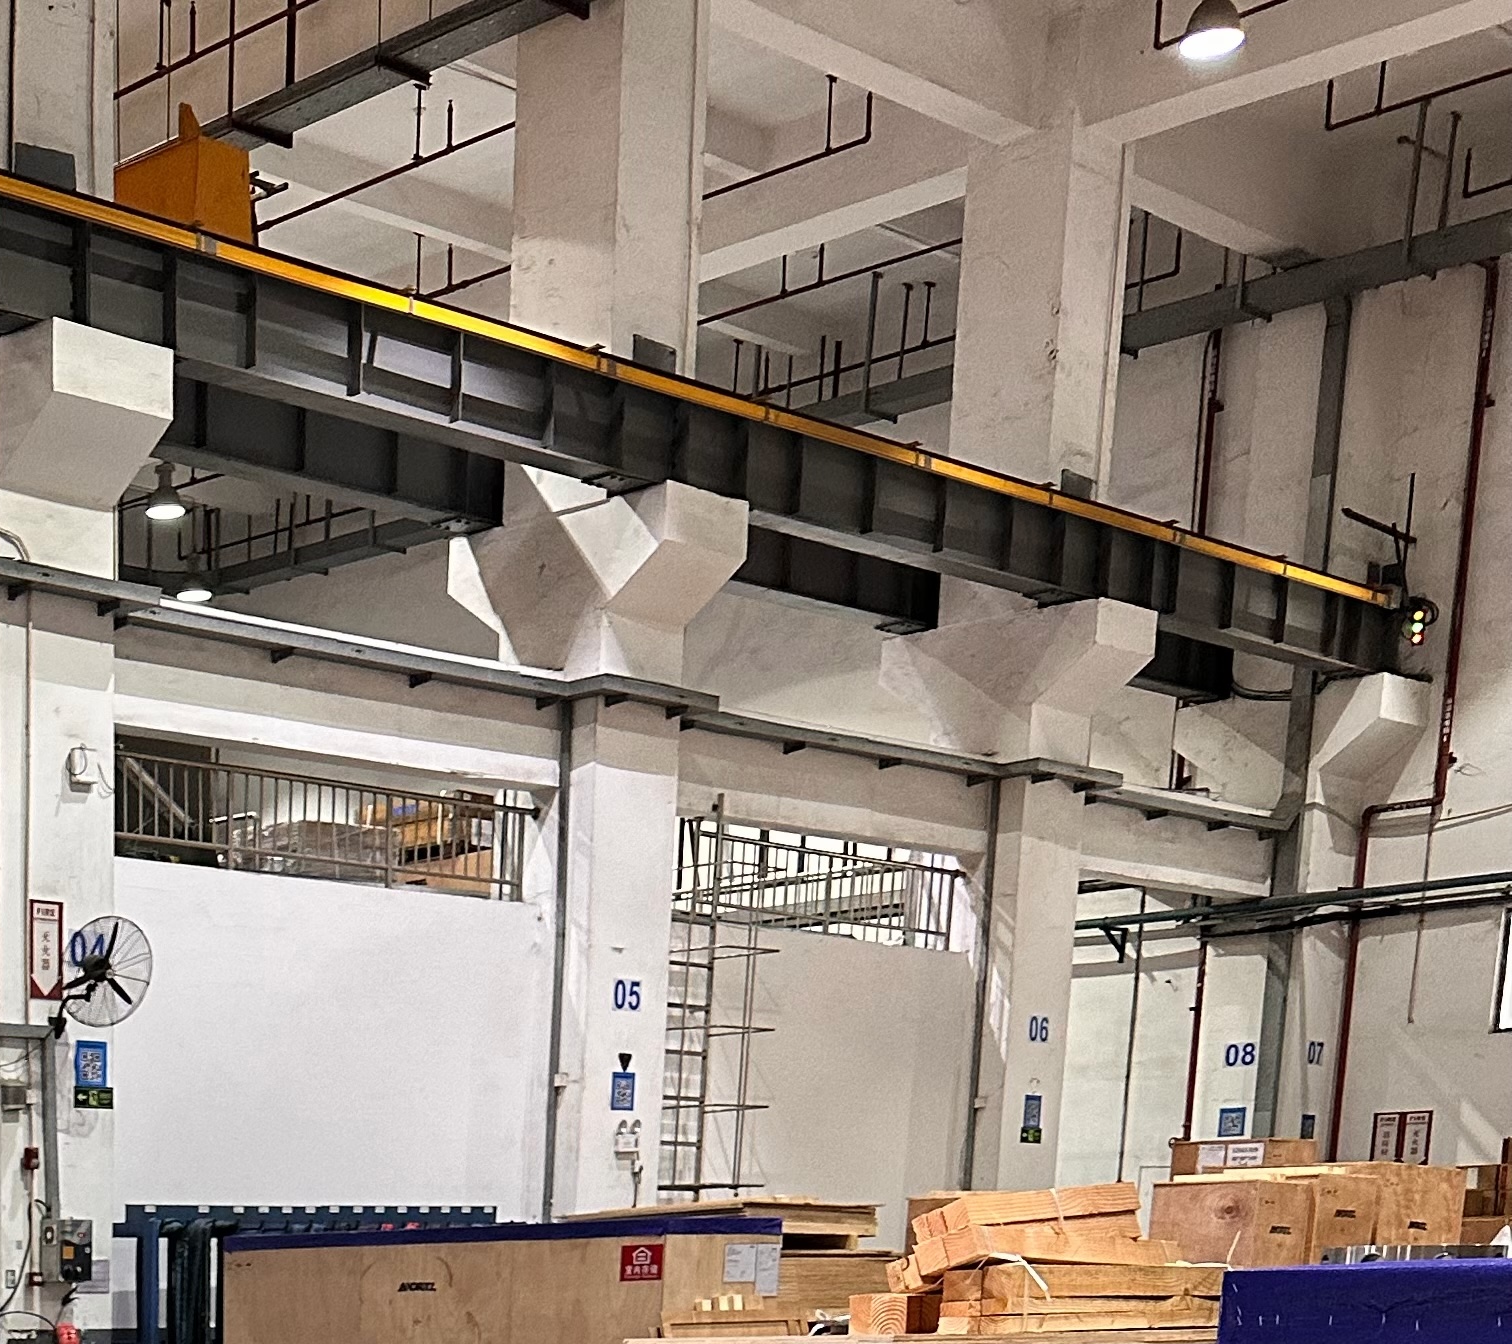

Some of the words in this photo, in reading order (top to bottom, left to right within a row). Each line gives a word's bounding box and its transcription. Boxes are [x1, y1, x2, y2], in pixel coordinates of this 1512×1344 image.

[614, 979, 641, 1011] 05
[1029, 1016, 1049, 1042] 06
[1225, 1043, 1255, 1067] 08
[1307, 1041, 1324, 1065] 07
